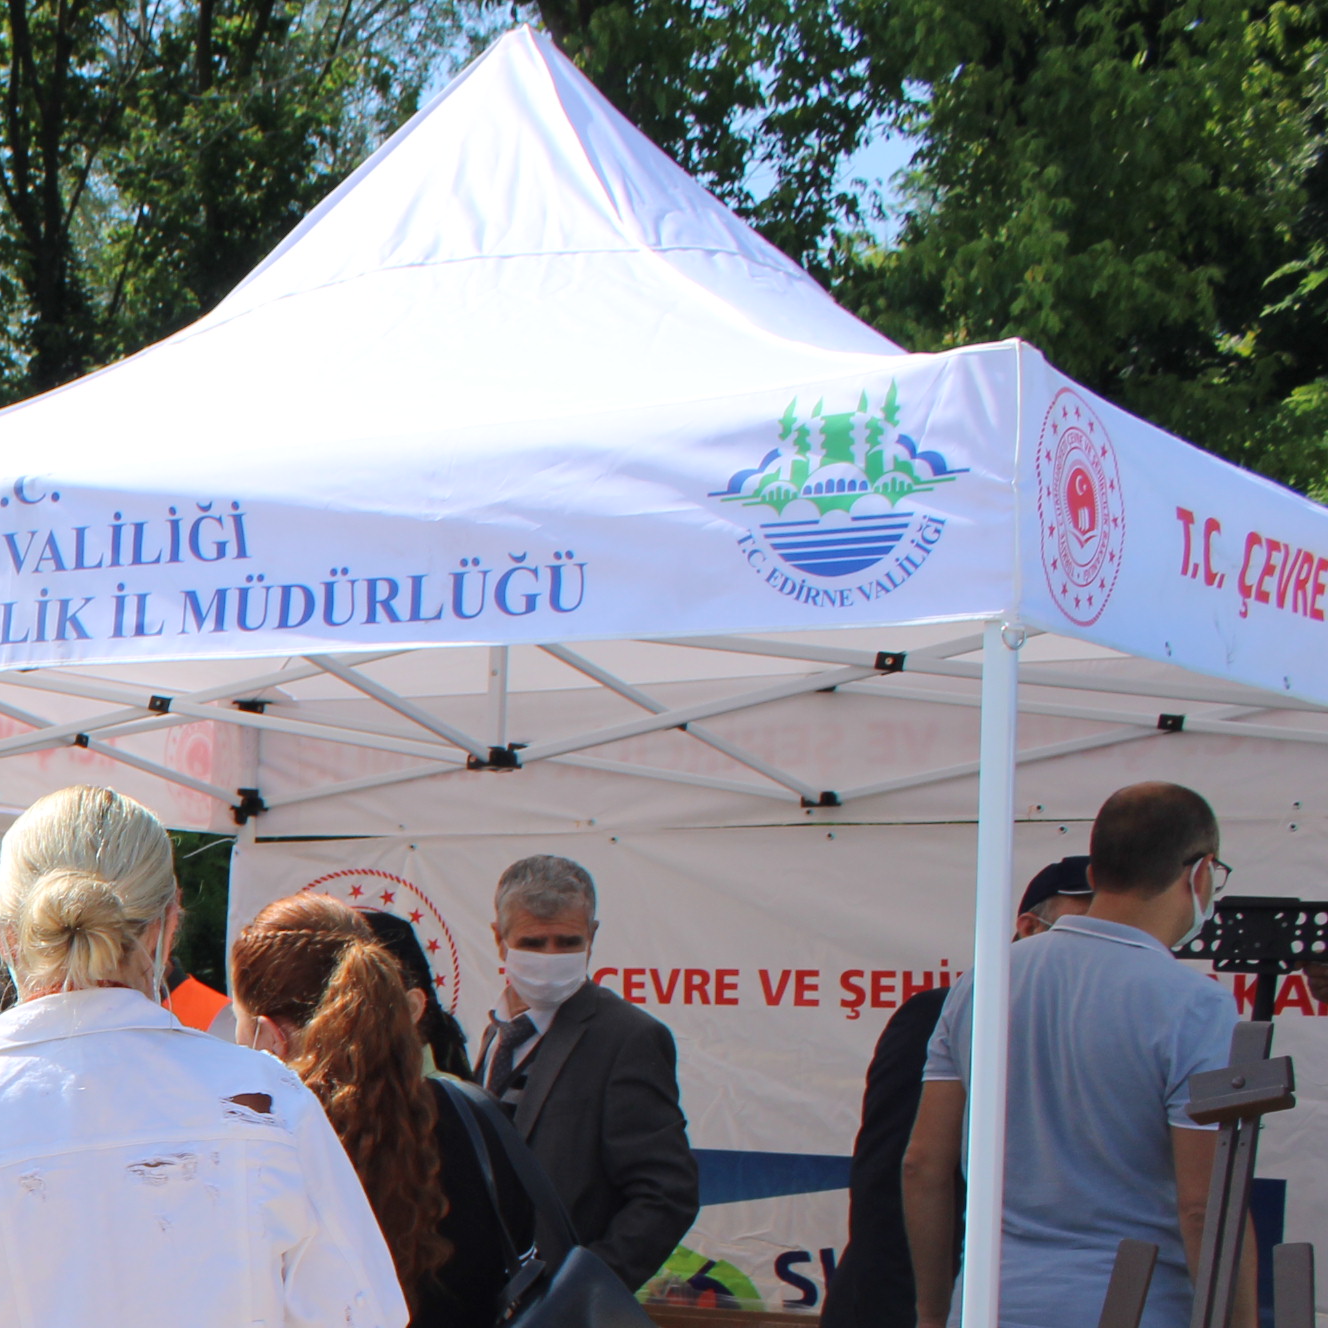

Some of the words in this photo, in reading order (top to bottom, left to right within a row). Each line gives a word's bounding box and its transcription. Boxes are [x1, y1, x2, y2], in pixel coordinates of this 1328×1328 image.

[3, 500, 252, 576] VALİLİĞİ
[765, 566, 854, 607] EDİRNE
[857, 515, 947, 602] VALİLİĞİ
[1176, 506, 1225, 588] T.C.
[1238, 531, 1328, 621] ÇEVRE
[110, 581, 166, 638] İL
[176, 550, 588, 634] MÜDÜRLÜĞÜ
[758, 969, 820, 1007] VE
